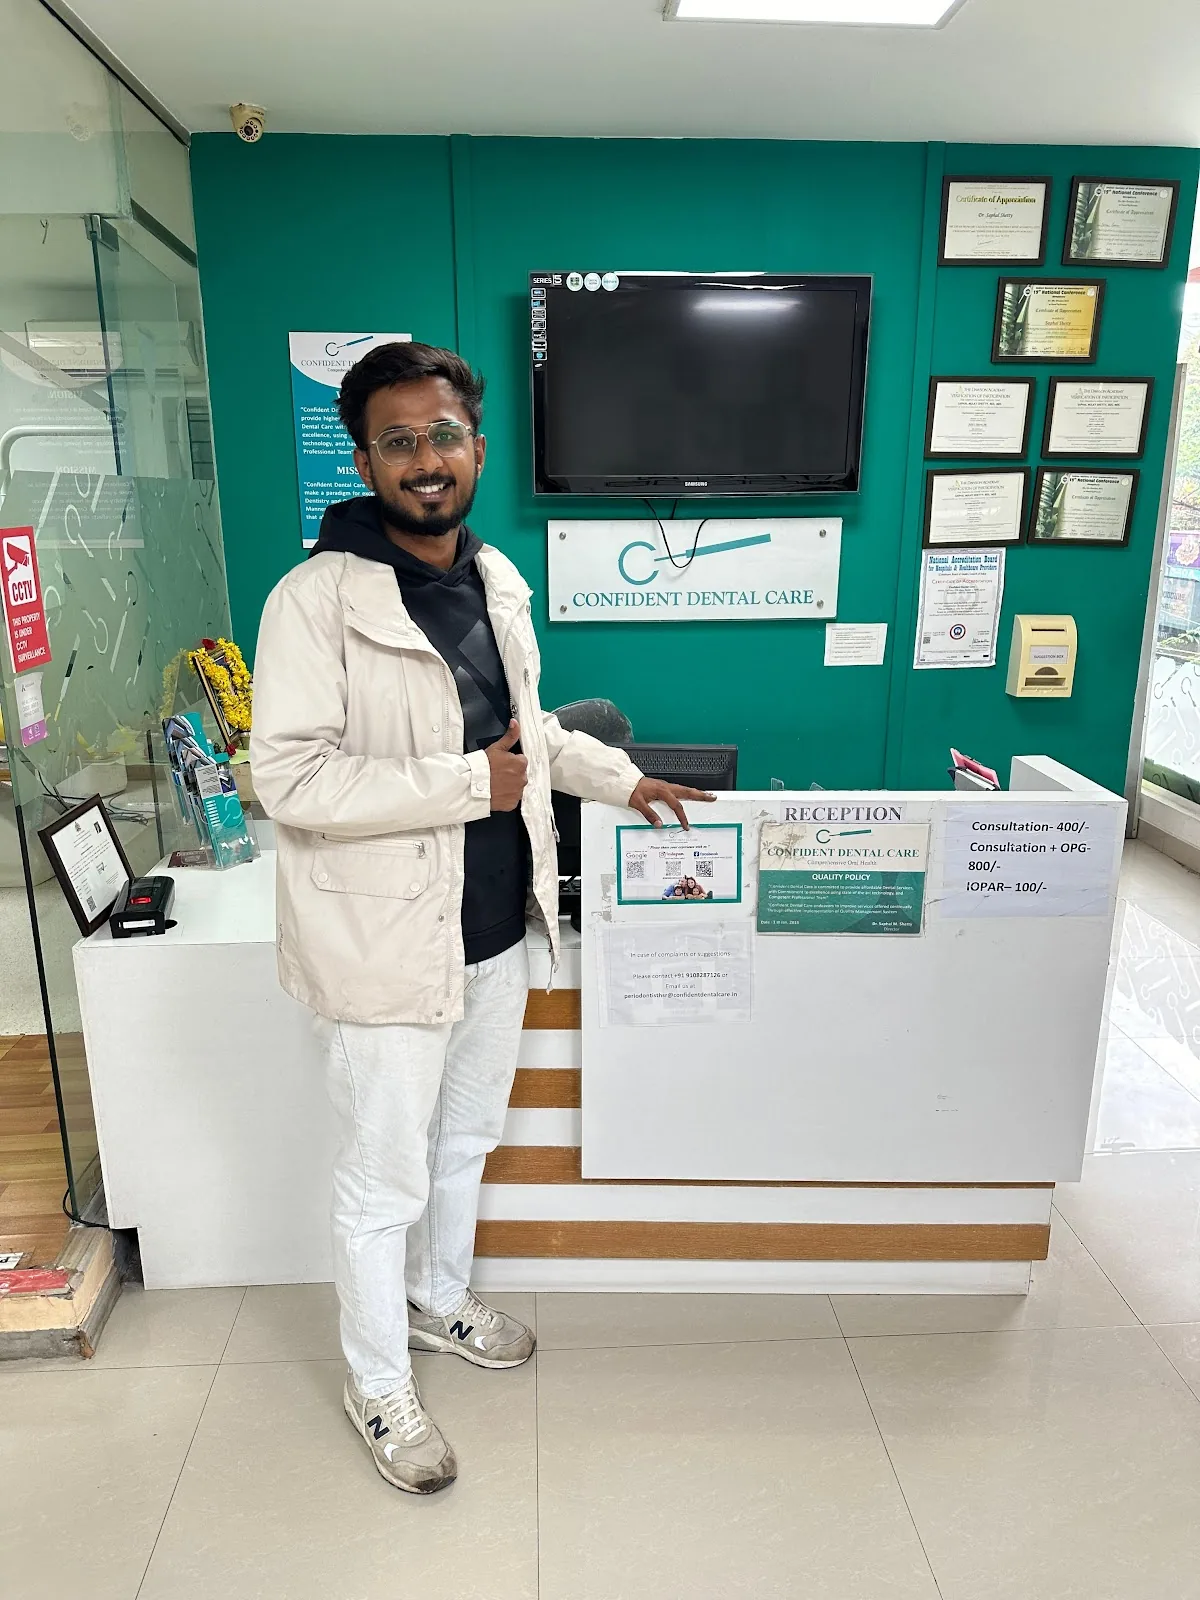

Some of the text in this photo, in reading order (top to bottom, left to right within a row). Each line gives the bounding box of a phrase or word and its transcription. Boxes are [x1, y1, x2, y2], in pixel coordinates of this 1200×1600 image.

[988, 196, 996, 204] of
[552, 274, 562, 286] 5
[336, 466, 360, 475] MISS
[929, 555, 998, 564] National Accreditation Board
[12, 580, 33, 602] CCTV
[572, 589, 815, 608] CONFIDENT DENTAL CARE
[12, 612, 41, 627] THIS PROPERTY
[14, 626, 33, 639] IS UNDER
[16, 639, 29, 652] CCTV
[17, 646, 47, 663] SURVEILLANCE
[785, 806, 903, 821] RECEPTION
[971, 821, 1090, 834] Consultation- 400/-
[767, 848, 920, 858] CONFIDENT DENTAL CARE
[970, 842, 1092, 853] Consultation + OPG-
[626, 852, 648, 860] Google
[807, 859, 847, 867] Comprehensive
[968, 860, 1001, 873] 800/-
[812, 873, 871, 882] QUALITY POLICY
[1015, 881, 1048, 894] 100/-
[450, 1320, 474, 1341] N
[366, 1414, 390, 1441] N
